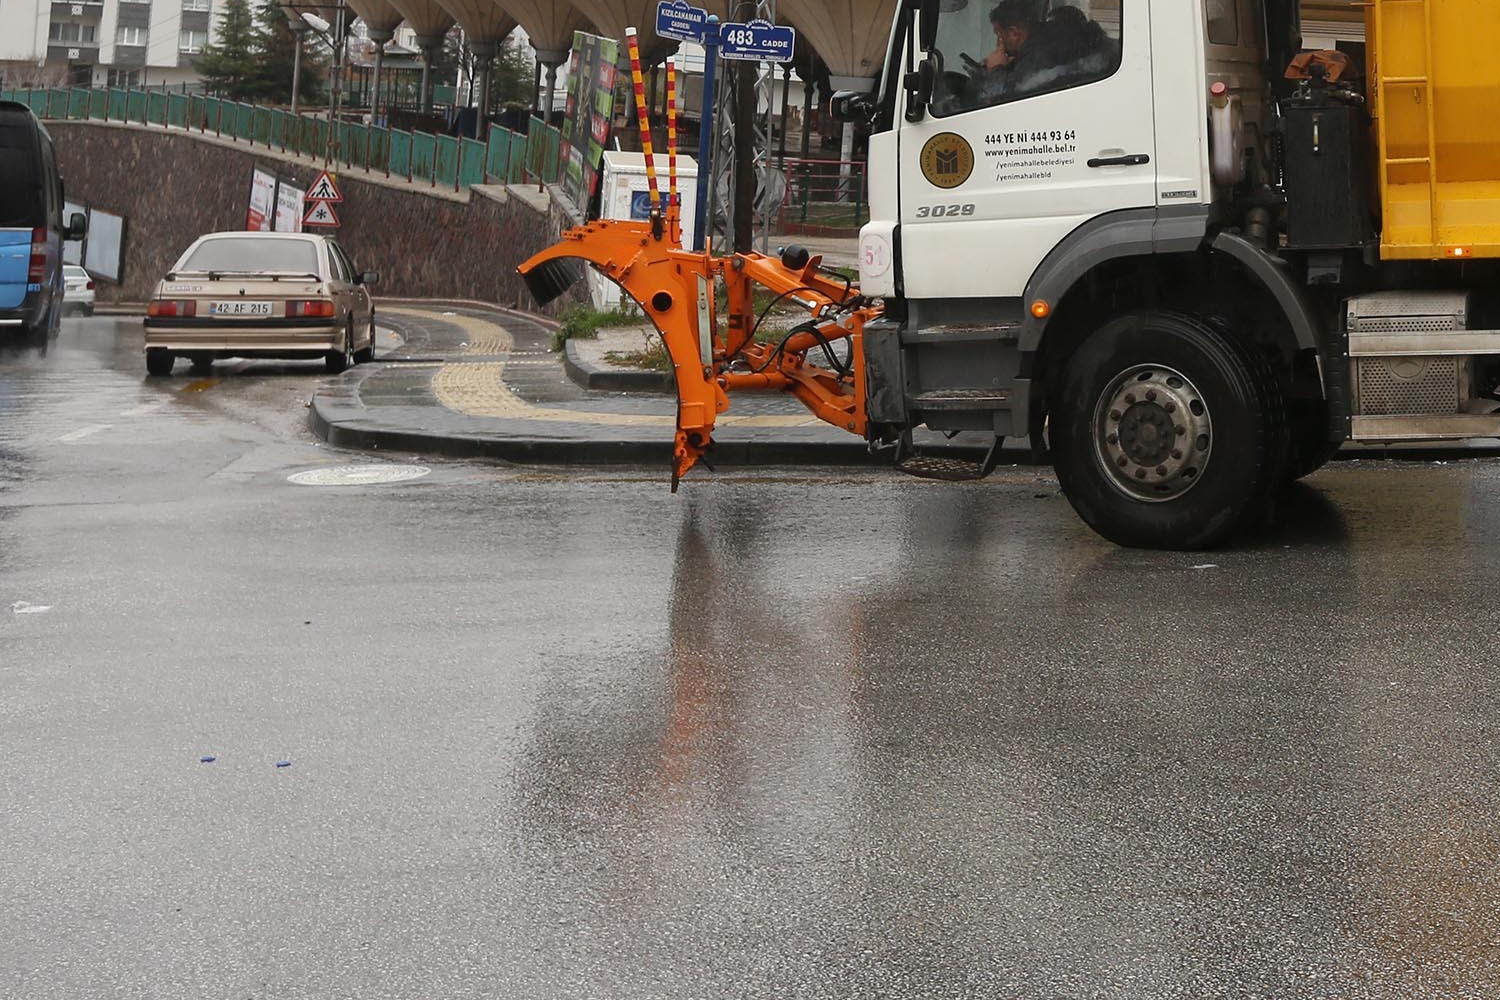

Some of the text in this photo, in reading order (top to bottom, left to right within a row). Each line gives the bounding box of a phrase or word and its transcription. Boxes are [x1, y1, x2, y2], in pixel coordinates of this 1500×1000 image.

[727, 29, 789, 48] 483. CADDE
[984, 130, 1076, 145] 444 YE Nİ 444 93 64
[984, 144, 1076, 158] www.yenimahalle.bel.tr
[996, 158, 1075, 170] /yenimahallebelediyesi
[915, 203, 976, 218] 3029
[217, 303, 268, 313] 42 AF 215
